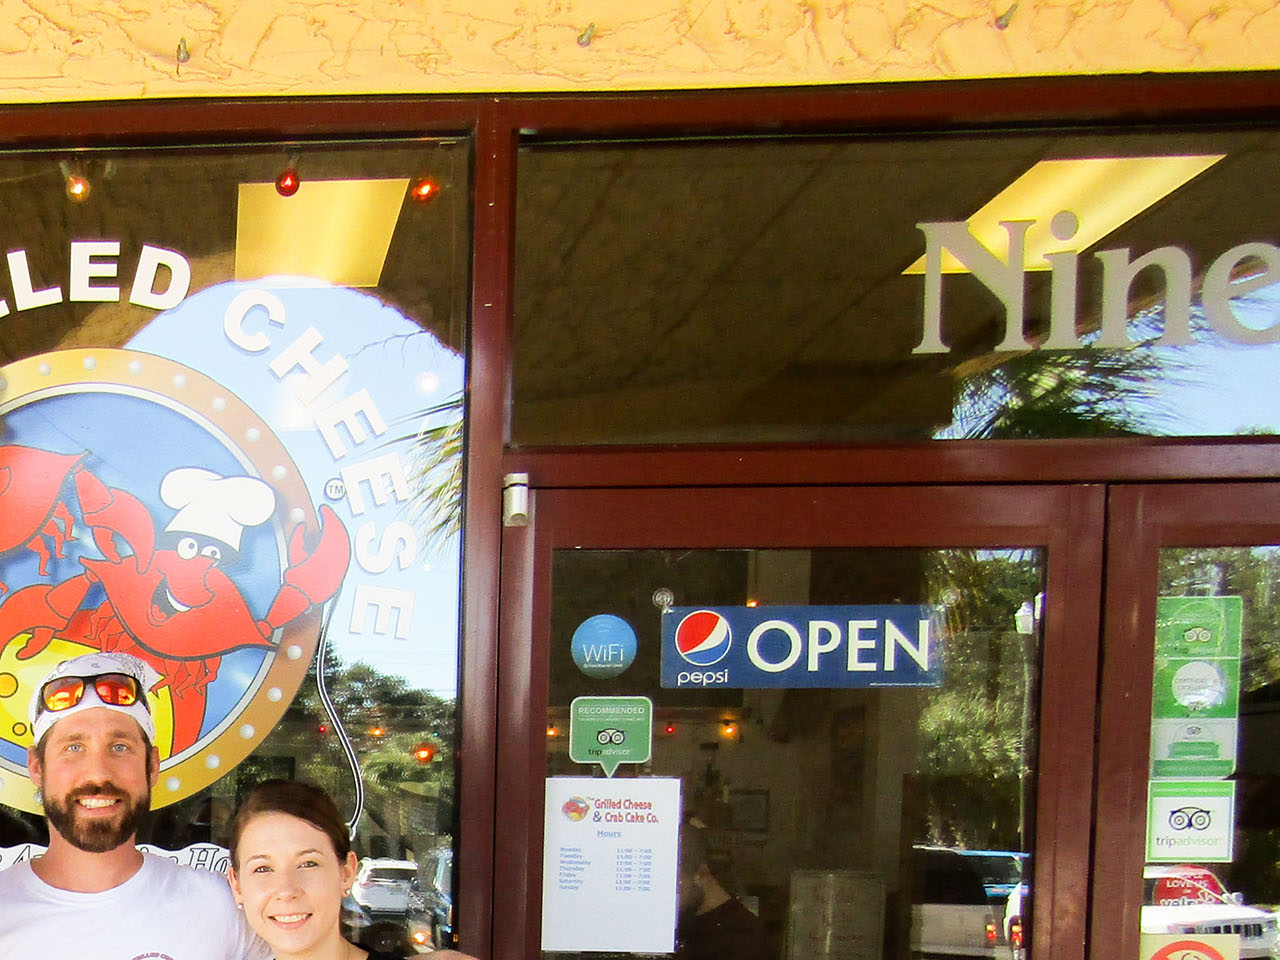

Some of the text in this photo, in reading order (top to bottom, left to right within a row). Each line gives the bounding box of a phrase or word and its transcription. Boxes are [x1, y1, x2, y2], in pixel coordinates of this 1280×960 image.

[911, 209, 1280, 355] Nine
[223, 287, 417, 640] CHEESE
[582, 643, 624, 662] WiFi
[746, 619, 931, 673] OPEN
[677, 669, 729, 686] pepsi
[588, 748, 631, 756] tripadvisor
[594, 799, 652, 810] Grilled Cheese
[592, 811, 658, 823] & Crab Cake Co.
[597, 830, 621, 838] Hours
[1156, 835, 1223, 848] tripadvisor
[1166, 880, 1193, 888] LOVE
